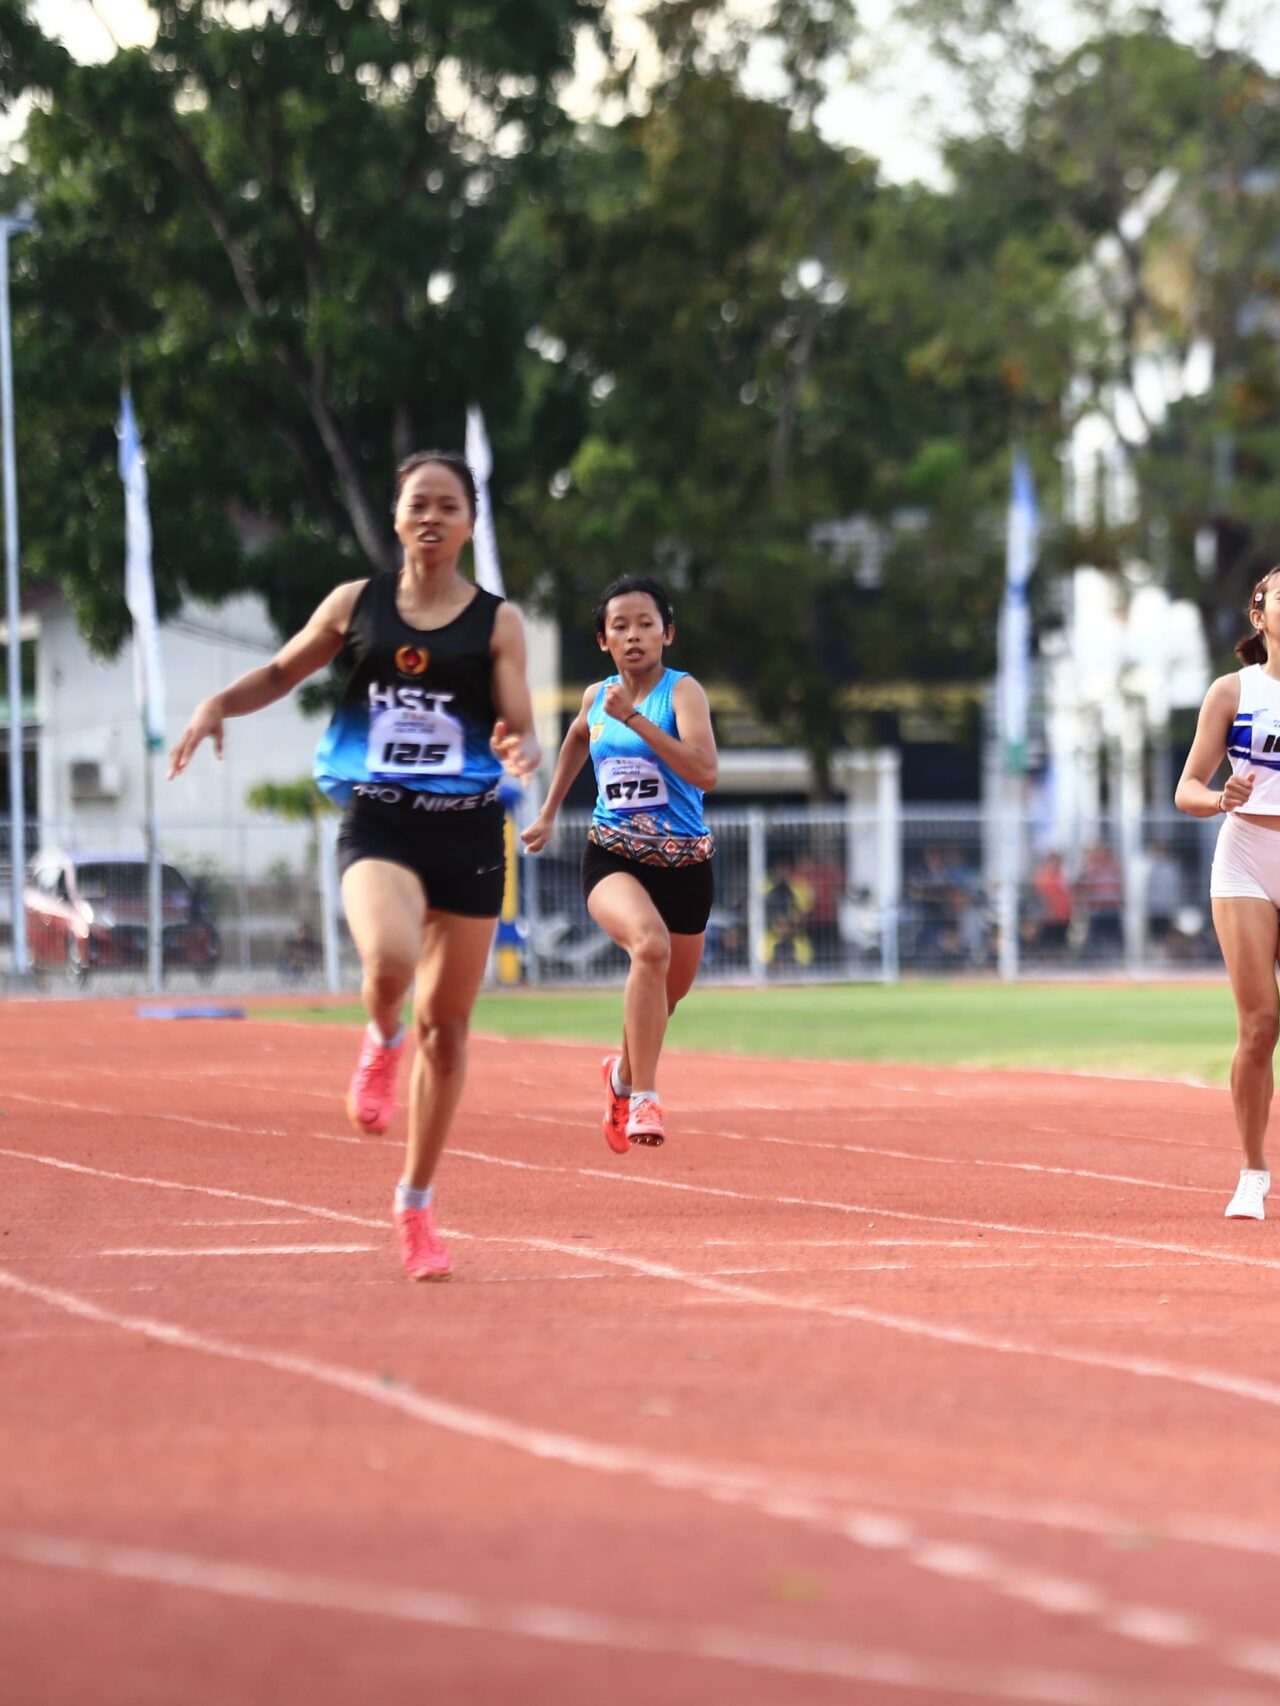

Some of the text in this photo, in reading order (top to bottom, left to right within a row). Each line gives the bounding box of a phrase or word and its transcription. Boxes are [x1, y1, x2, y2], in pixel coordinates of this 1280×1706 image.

[369, 681, 455, 714] HST
[382, 742, 451, 765] 125
[411, 795, 480, 812] NIKE
